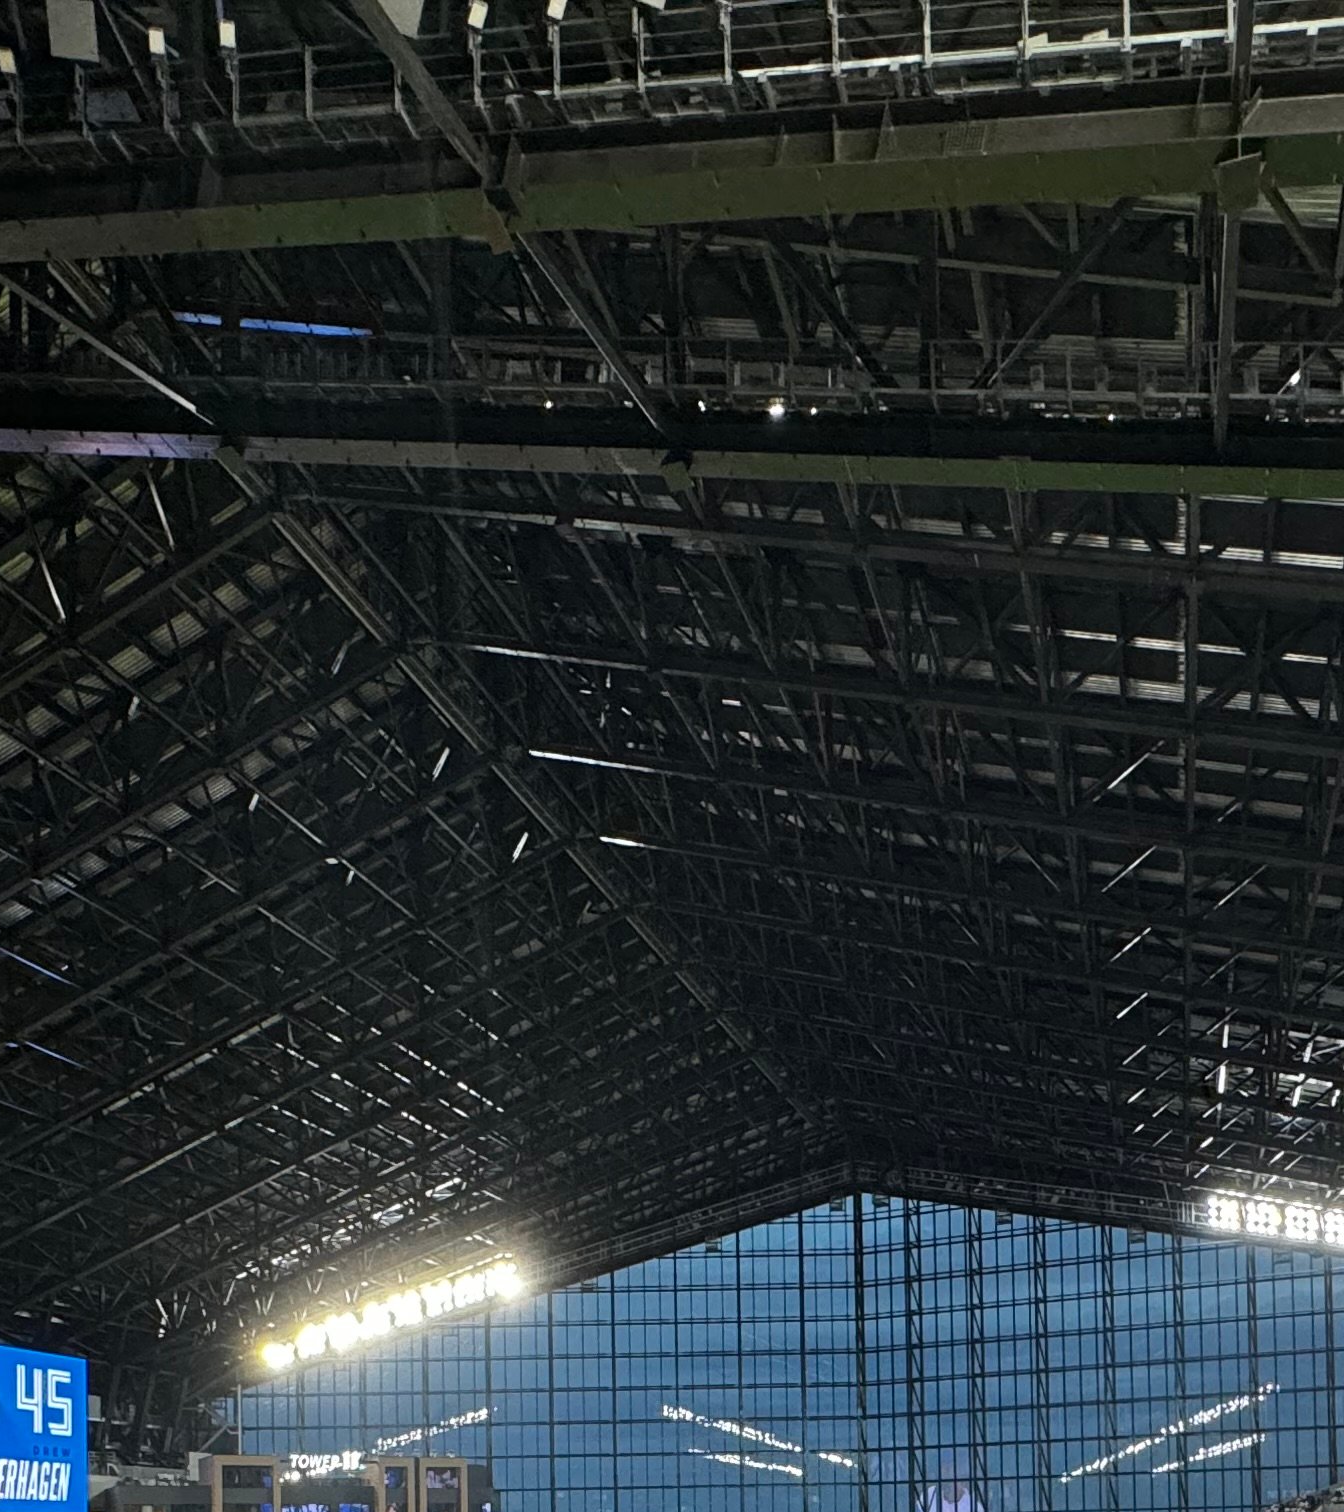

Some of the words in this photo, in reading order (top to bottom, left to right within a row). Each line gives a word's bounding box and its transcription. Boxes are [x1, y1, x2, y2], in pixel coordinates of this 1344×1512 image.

[16, 1363, 73, 1437] 45
[33, 1446, 71, 1457] DREW
[289, 1453, 342, 1470] TOWER
